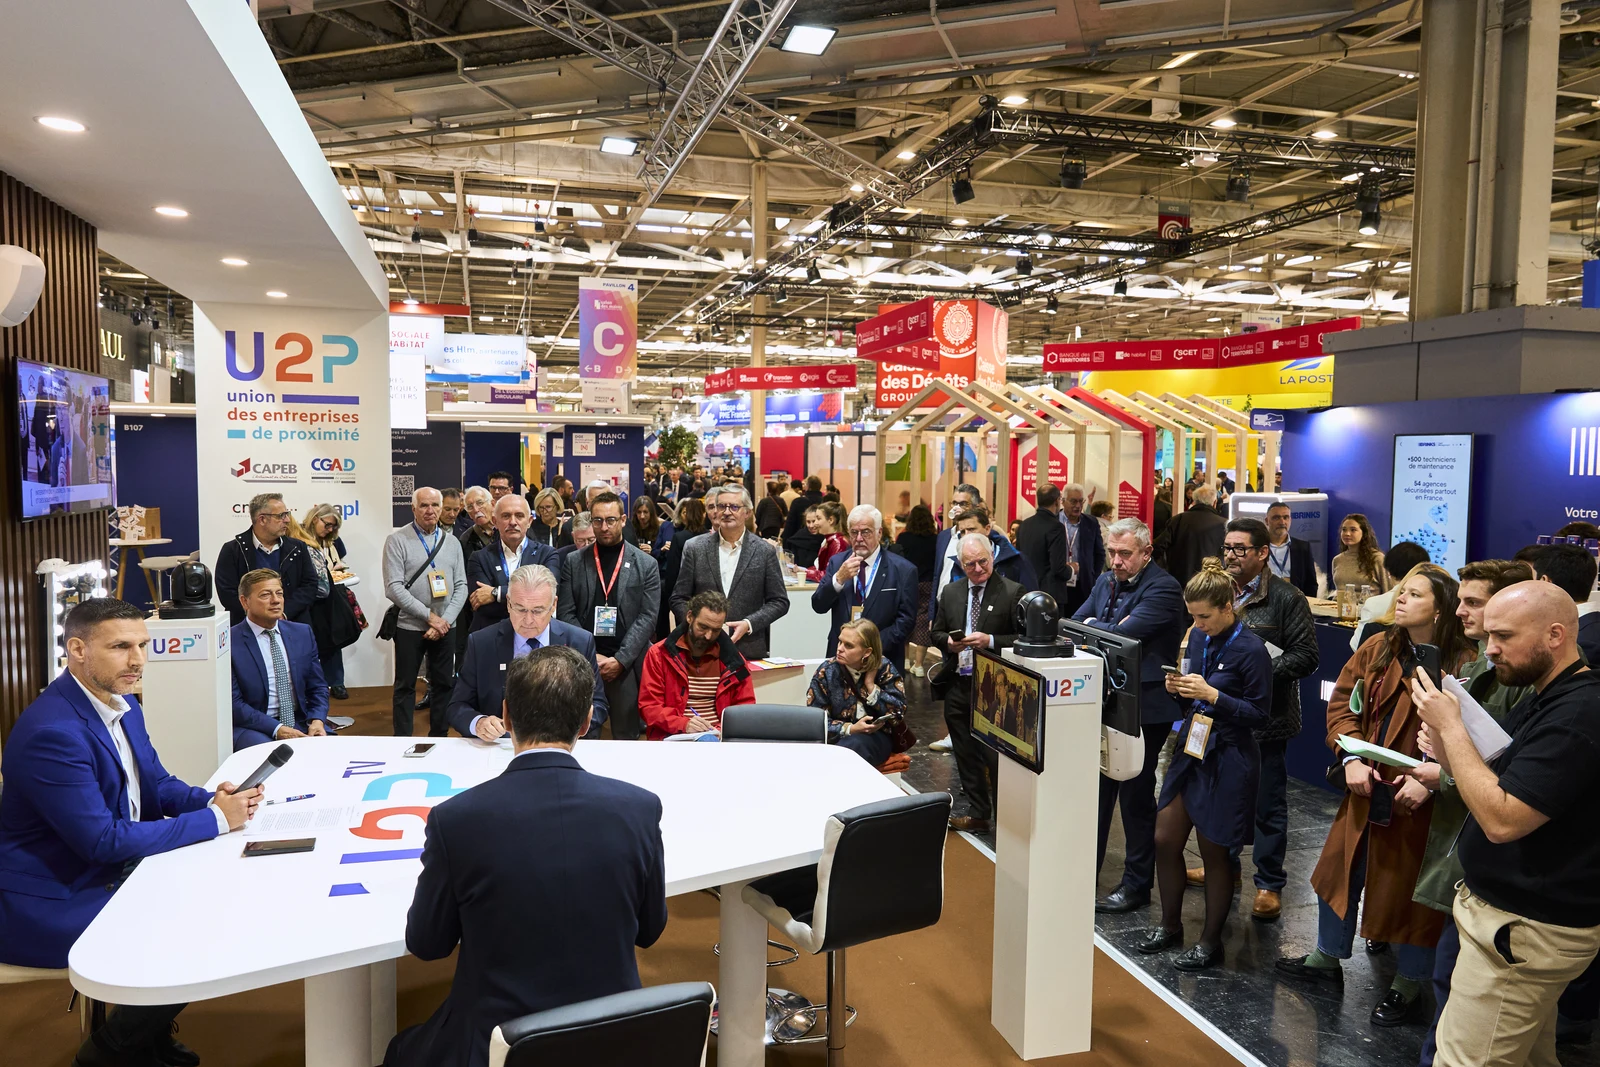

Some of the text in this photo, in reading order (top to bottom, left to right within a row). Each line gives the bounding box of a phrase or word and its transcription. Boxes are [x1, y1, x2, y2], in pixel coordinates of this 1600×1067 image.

[627, 284, 635, 292] 4
[100, 328, 126, 361] AUL
[593, 322, 624, 356] C
[225, 330, 358, 383] U2P
[456, 346, 478, 354] Hlm,
[594, 364, 602, 372] B
[616, 366, 623, 374] D
[978, 356, 995, 374] Caisse
[882, 374, 910, 389] des
[1280, 374, 1334, 384] LA POST
[227, 389, 276, 403] union
[720, 402, 746, 412] Village des
[227, 407, 359, 425] des entreprises
[252, 426, 360, 442] de proximité
[252, 463, 298, 474] CAPEB
[311, 458, 356, 471] CGAD
[1294, 511, 1320, 519] BRINKS
[1565, 506, 1598, 518] Votre
[153, 638, 195, 654] U2P
[1046, 678, 1085, 698] U2P
[342, 760, 386, 778] TV
